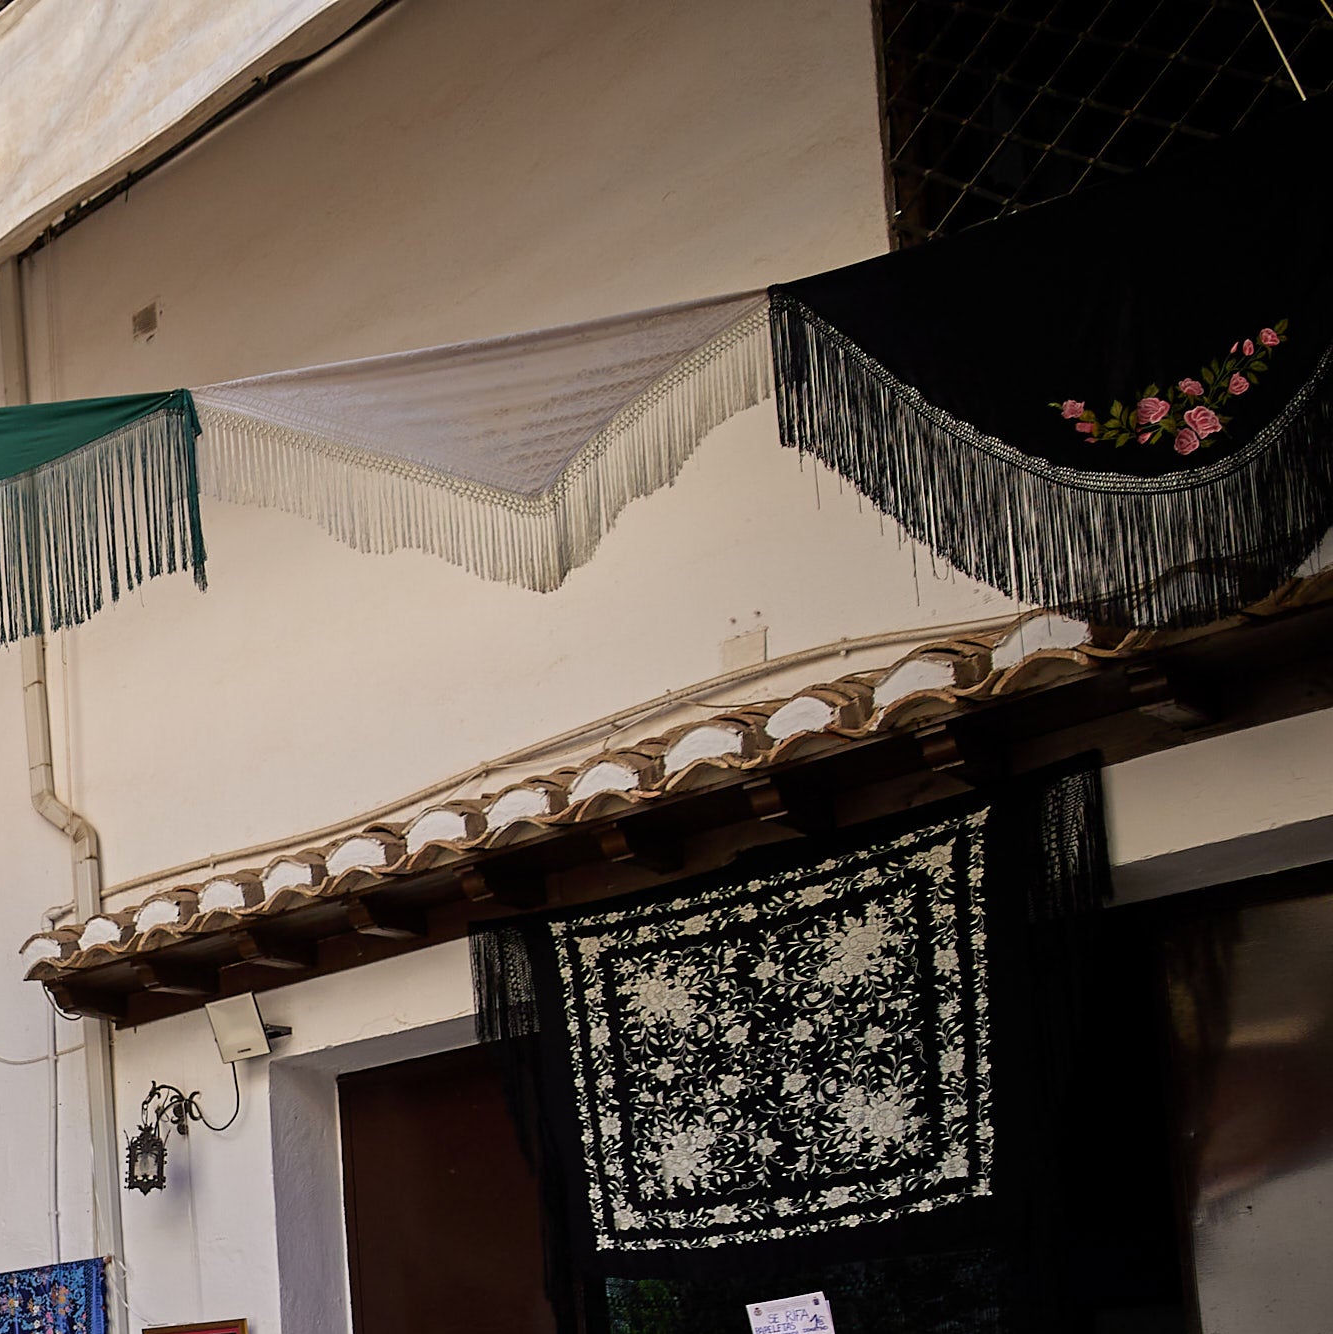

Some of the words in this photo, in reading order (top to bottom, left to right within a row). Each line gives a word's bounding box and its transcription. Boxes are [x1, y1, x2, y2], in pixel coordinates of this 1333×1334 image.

[767, 1313, 780, 1324] SE
[786, 1309, 809, 1322] RIFA
[755, 1322, 797, 1334] PAPELETAS
